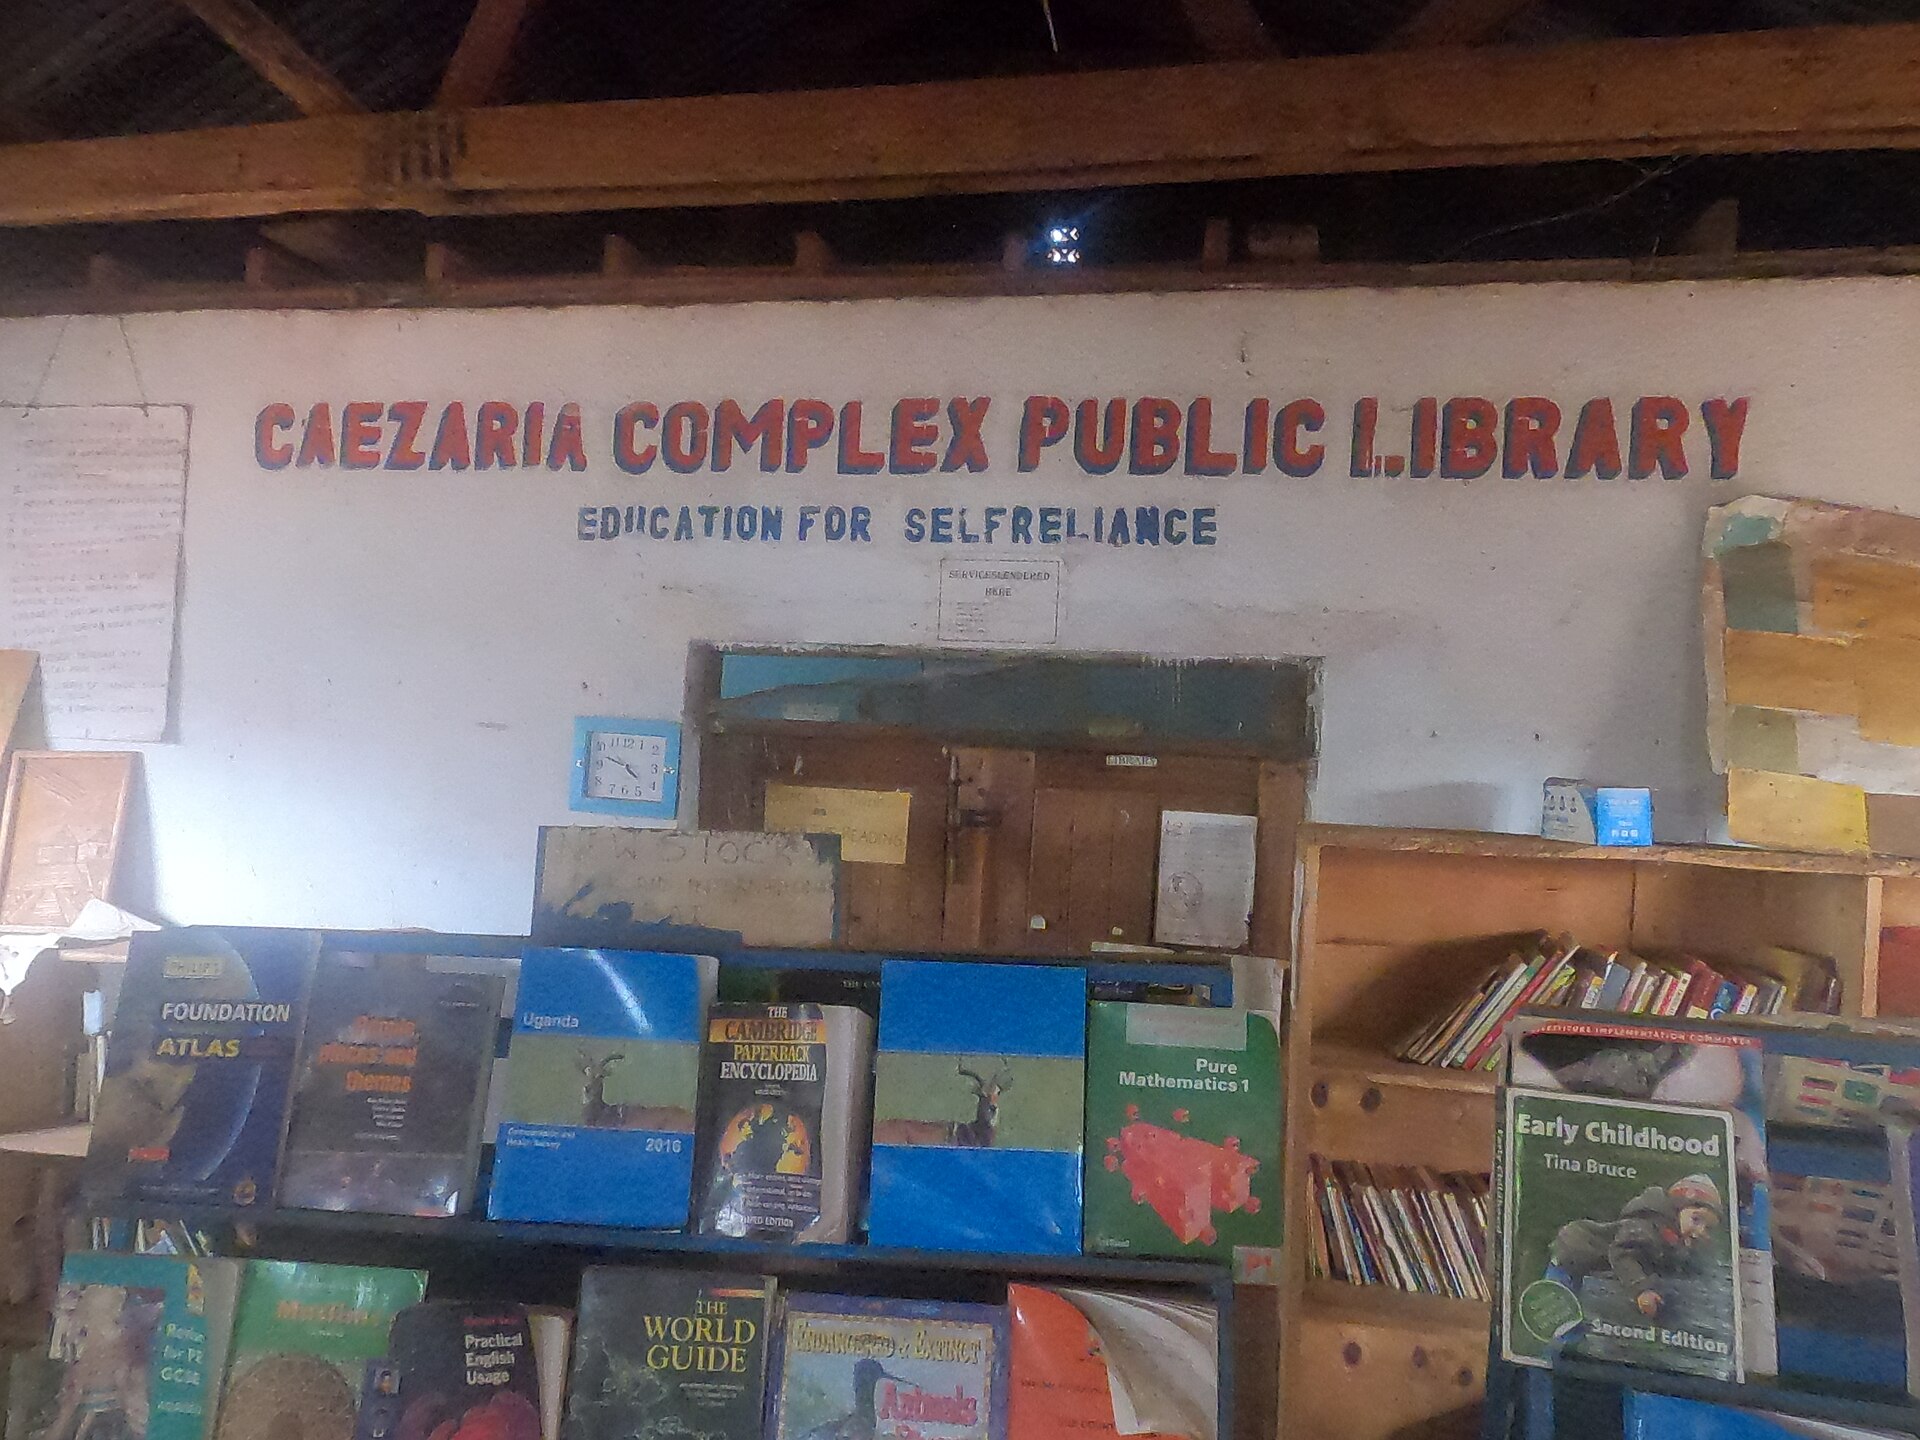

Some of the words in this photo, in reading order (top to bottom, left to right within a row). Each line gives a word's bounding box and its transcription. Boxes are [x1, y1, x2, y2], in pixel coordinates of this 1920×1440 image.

[255, 402, 587, 472] CAEZARIA
[614, 396, 991, 475] COMPLEX
[1016, 395, 1326, 478] PUBLIC
[1349, 395, 1749, 480] LIBRARY
[799, 506, 871, 542] FOR
[162, 1002, 290, 1022] FOUNDATION
[523, 1012, 579, 1029] Uganda
[767, 1006, 788, 1018] THE
[156, 1037, 241, 1057] ATLAS
[734, 1045, 810, 1062] PAPERBACK
[720, 1062, 818, 1081] ENCYCLOPEDIA
[1196, 1058, 1238, 1075] Pure
[1119, 1071, 1238, 1093] Mathematics
[1241, 1079, 1250, 1093] 1
[1517, 1113, 1580, 1146] Early
[1585, 1121, 1720, 1157] Childhood
[645, 1138, 682, 1153] 2016
[1544, 1153, 1581, 1171] Tina
[1586, 1159, 1638, 1179] Bruce
[696, 1300, 728, 1315] THE
[643, 1315, 757, 1344] WORLD
[1591, 1318, 1657, 1343] Second
[1661, 1327, 1728, 1354] Edition
[465, 1332, 523, 1349] Practical
[465, 1350, 515, 1368] English
[646, 1344, 747, 1372] GUIDE
[466, 1370, 510, 1386] Usage
